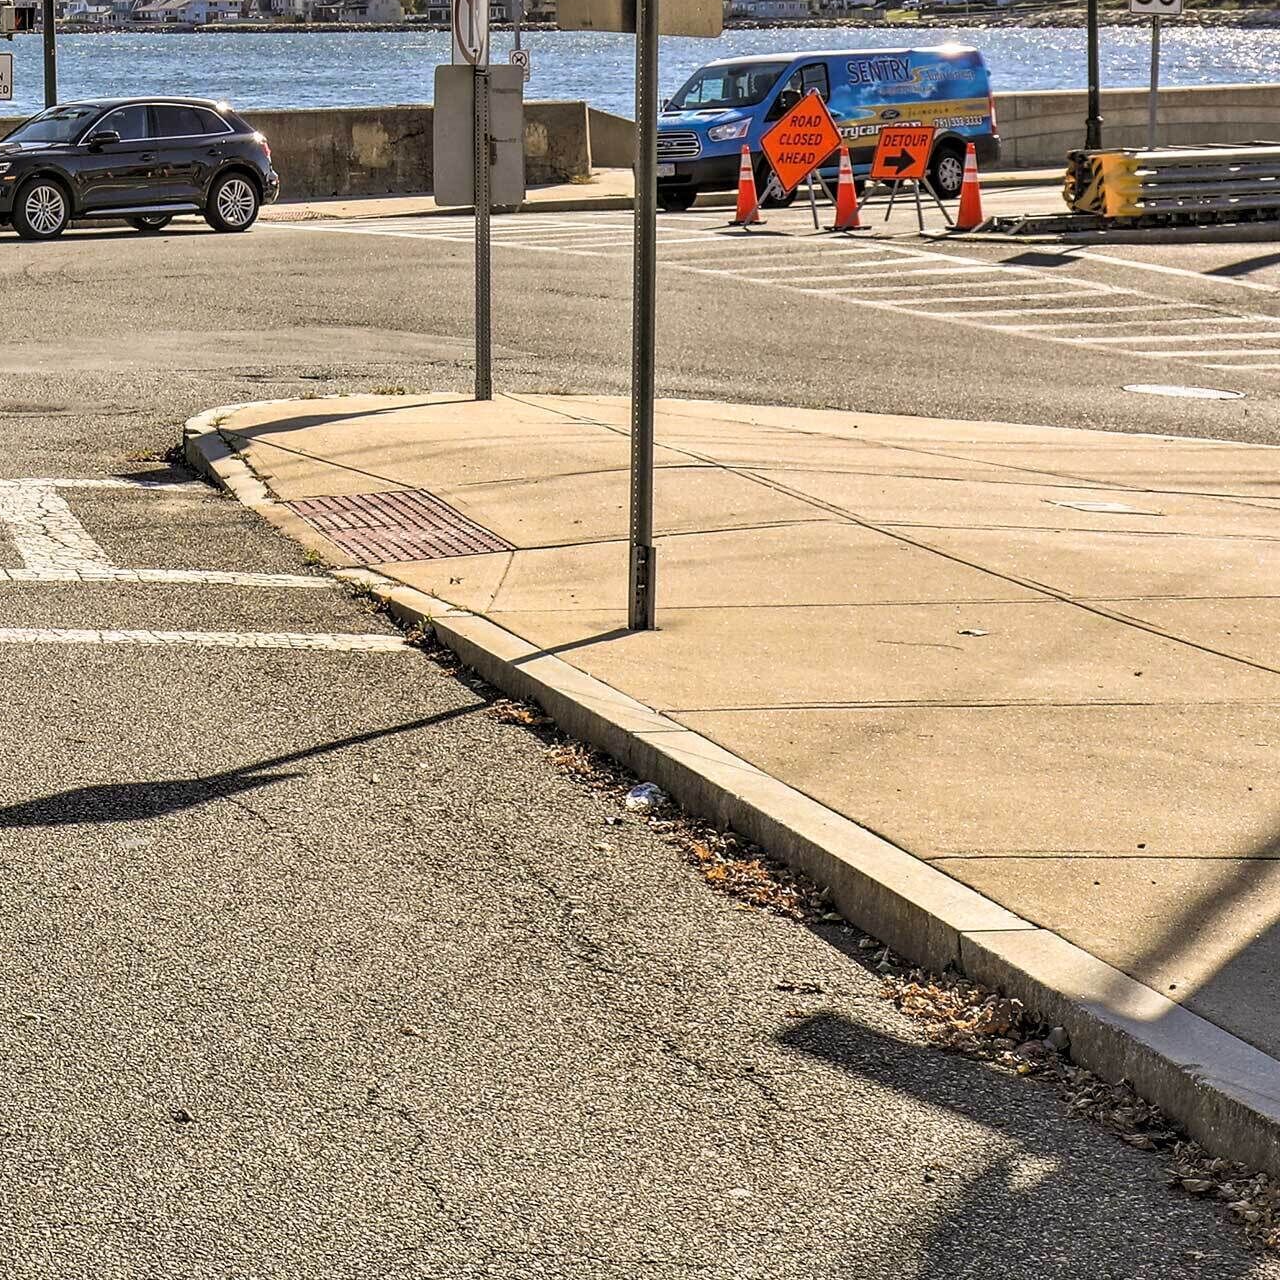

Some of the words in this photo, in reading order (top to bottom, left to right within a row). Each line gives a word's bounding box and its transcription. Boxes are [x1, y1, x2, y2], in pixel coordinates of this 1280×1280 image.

[847, 58, 911, 84] SENTRY
[790, 115, 822, 127] ROAD
[779, 133, 823, 146] CLOSED
[883, 134, 929, 147] DETOUR
[778, 152, 816, 164] AHEAD
